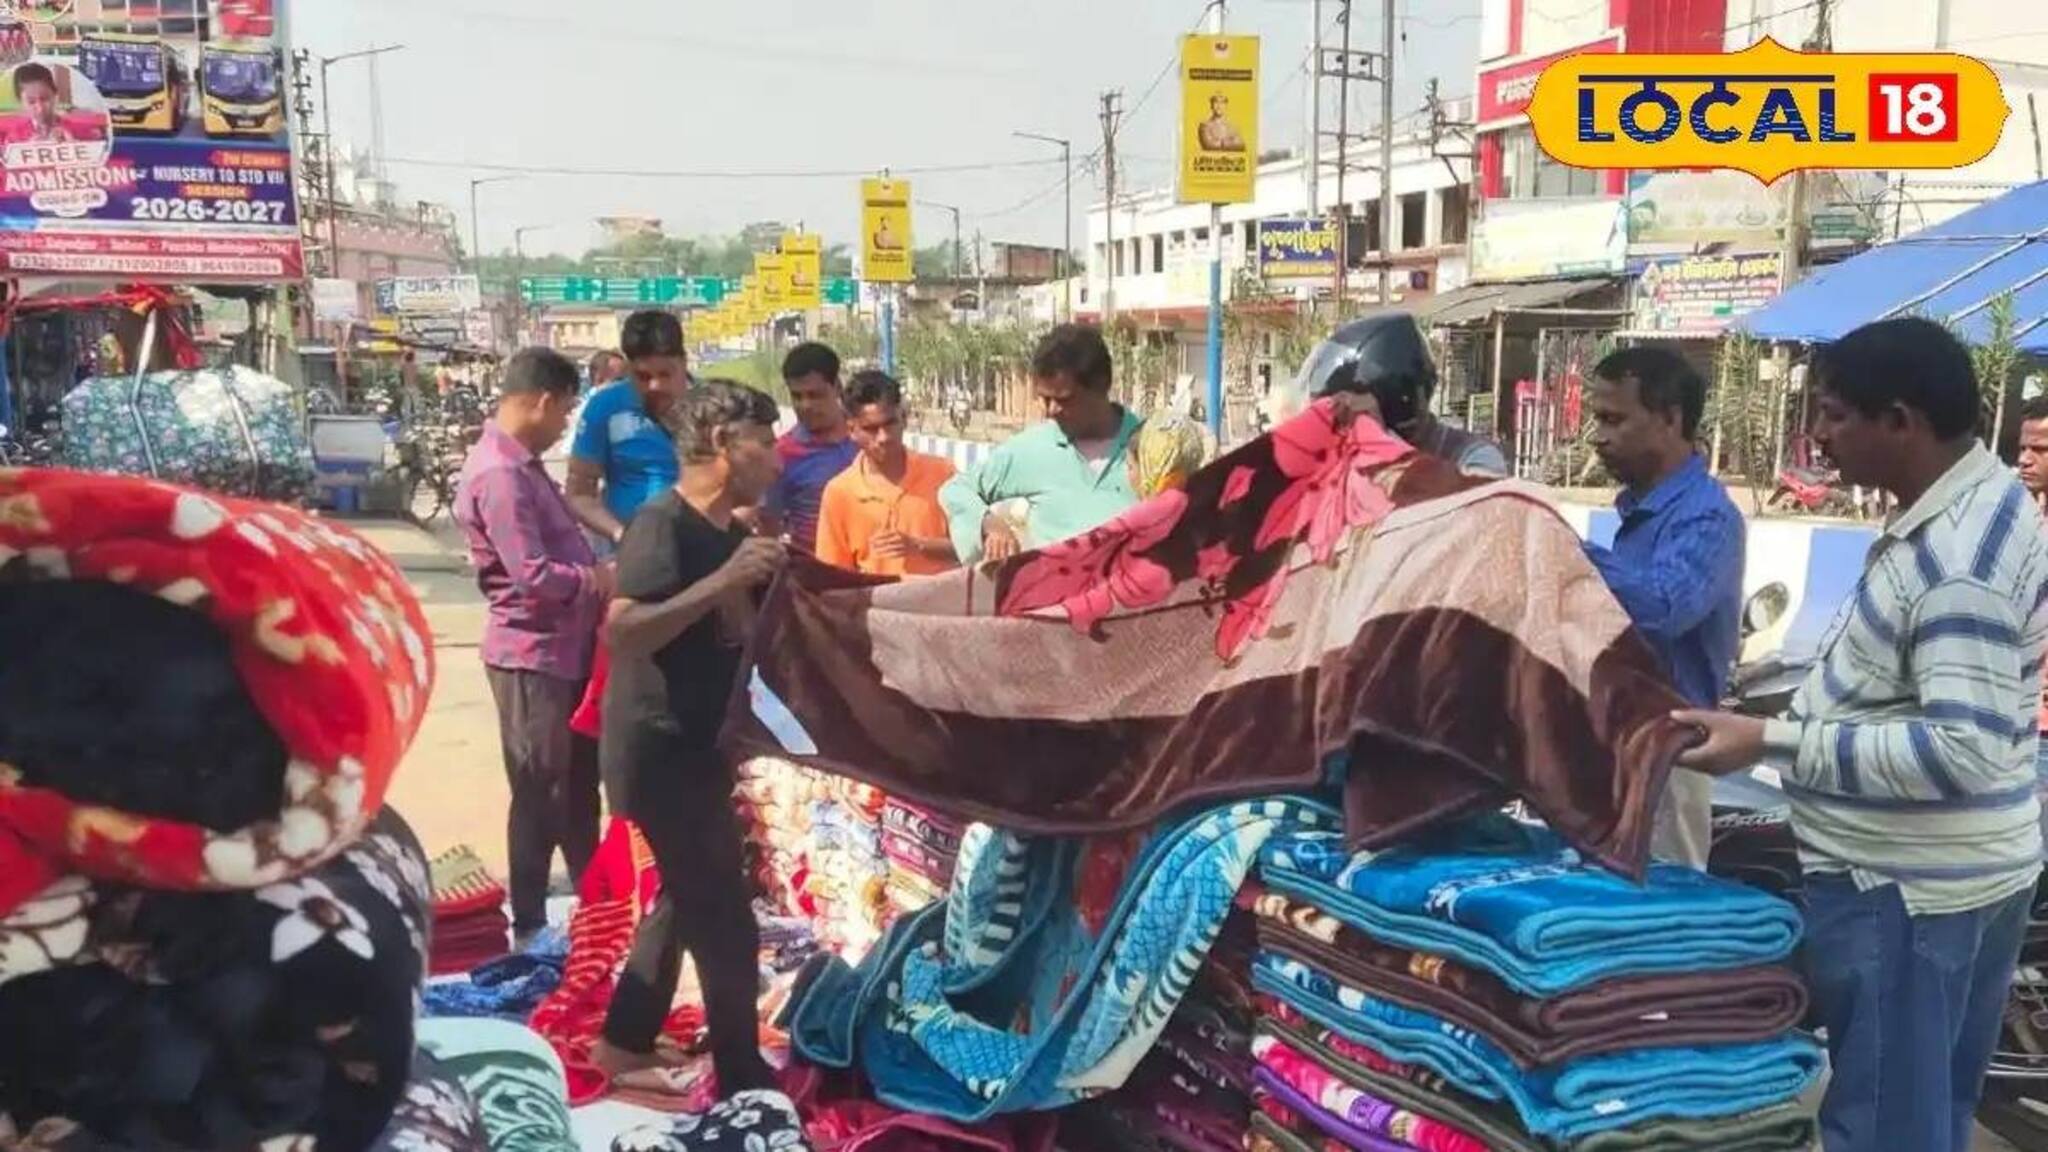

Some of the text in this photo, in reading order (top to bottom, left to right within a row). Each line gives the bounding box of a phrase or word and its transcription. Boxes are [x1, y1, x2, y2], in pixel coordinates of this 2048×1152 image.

[21, 145, 90, 163] FREE
[4, 165, 131, 192] ADMISSION
[153, 166, 215, 182] NURSERY
[218, 168, 235, 183] TO
[238, 169, 264, 184] STD
[131, 197, 286, 222] 2026-2027
